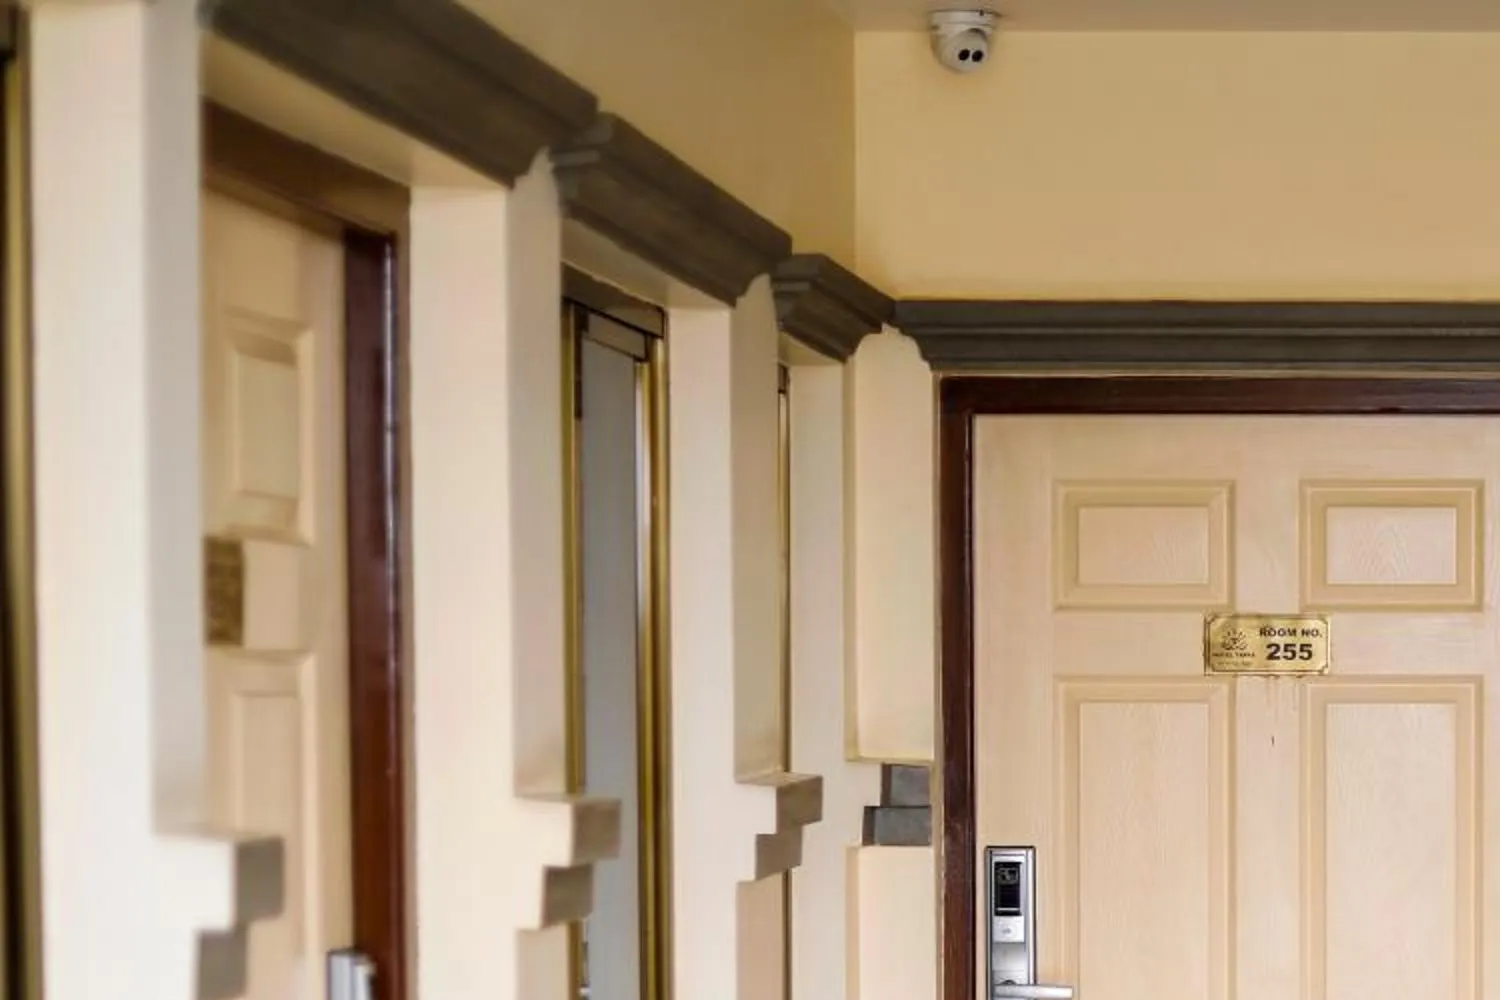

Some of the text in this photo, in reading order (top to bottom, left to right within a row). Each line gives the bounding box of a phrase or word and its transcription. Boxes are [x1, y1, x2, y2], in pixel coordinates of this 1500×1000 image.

[1259, 627, 1323, 638] ROOM NO.
[1266, 643, 1313, 661] 255
